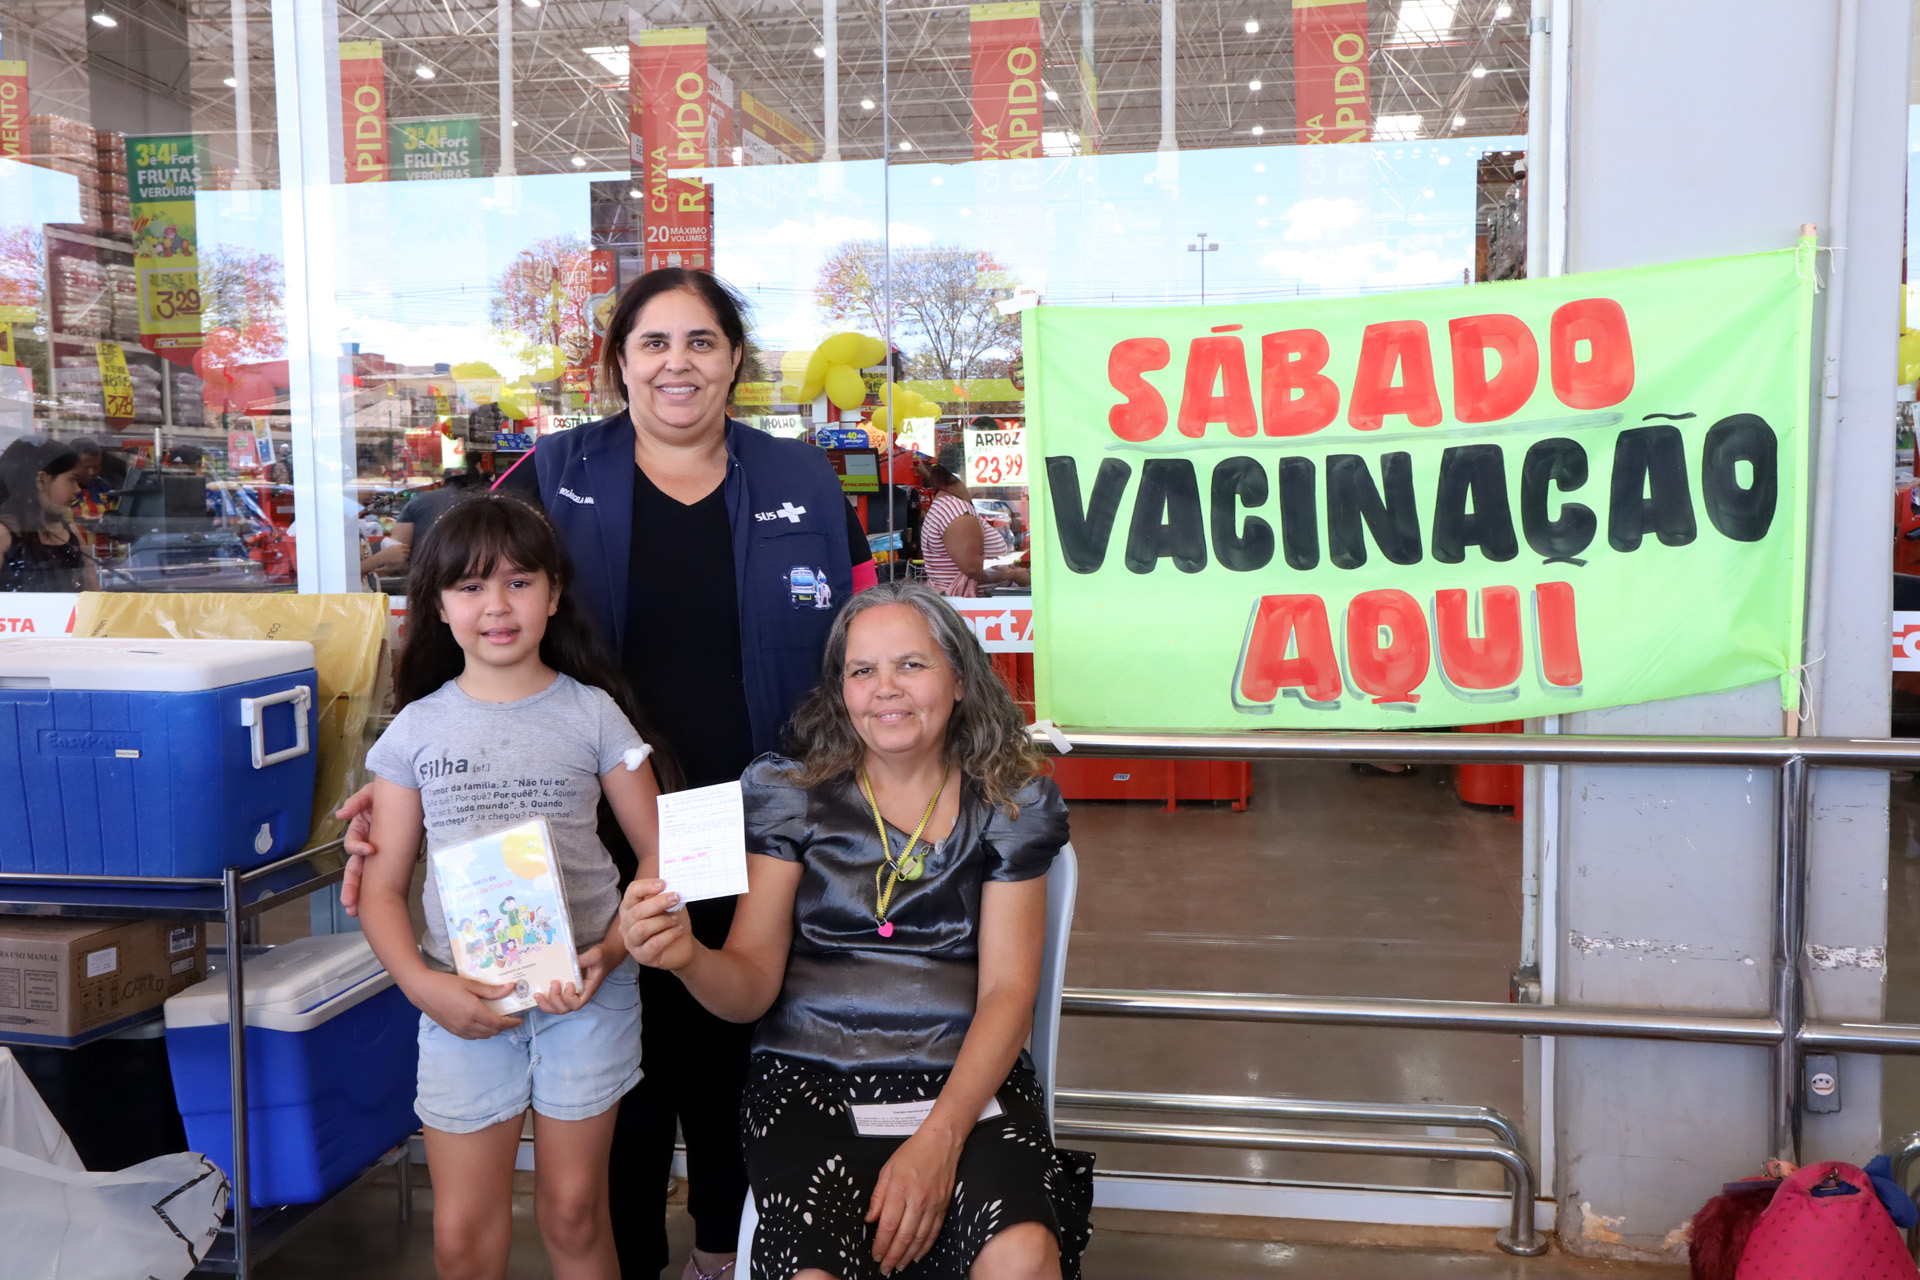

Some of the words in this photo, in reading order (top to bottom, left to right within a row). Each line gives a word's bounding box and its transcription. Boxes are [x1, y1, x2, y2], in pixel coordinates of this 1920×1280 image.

[439, 136, 470, 149] Fort
[170, 153, 201, 165] Fort
[403, 150, 471, 169] FRUTAS
[137, 166, 203, 185] FRUTAS
[405, 168, 471, 182] VERDURAS
[651, 145, 668, 213] CAIXA
[647, 225, 670, 243] 20
[670, 225, 708, 235] MÁXIMO
[670, 234, 708, 243] VOLUMES
[1107, 298, 1635, 443] SÁBADO
[759, 416, 797, 430] MOLHO
[846, 431, 858, 440] 40
[975, 431, 1021, 447] ARROZ
[1045, 412, 1779, 575] VACINAÇÃO
[754, 511, 778, 522] SUS
[1234, 581, 1584, 708] AQUI
[419, 757, 469, 780] Filha
[451, 784, 462, 792] da
[539, 778, 552, 787] fui
[455, 793, 469, 802] Por
[493, 791, 509, 800] Por
[543, 788, 551, 797] 4.
[552, 788, 577, 798] Aquela
[519, 800, 528, 809] 5.
[530, 799, 563, 808] Quando
[445, 813, 474, 827] chegar?
[487, 810, 526, 822] chegou?
[26, 952, 60, 963] MANUAL
